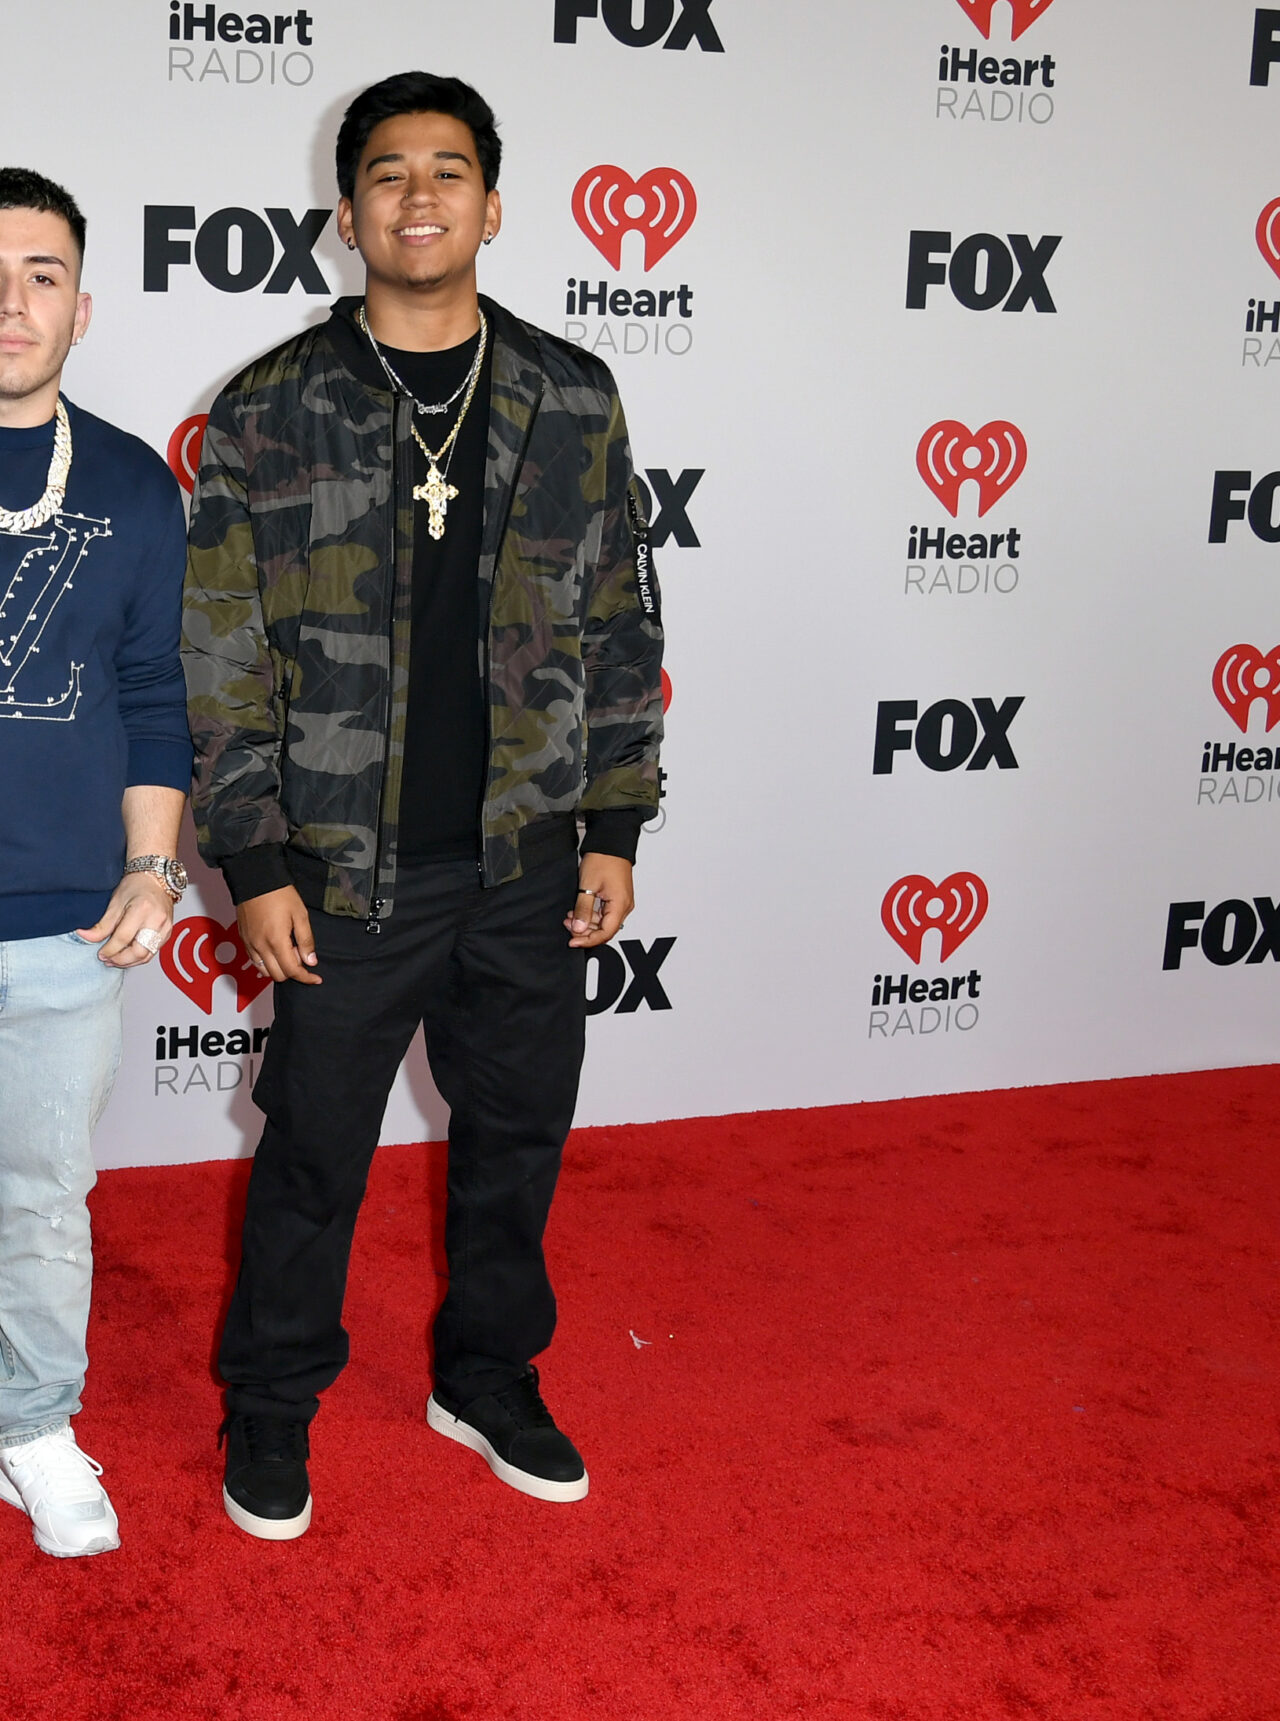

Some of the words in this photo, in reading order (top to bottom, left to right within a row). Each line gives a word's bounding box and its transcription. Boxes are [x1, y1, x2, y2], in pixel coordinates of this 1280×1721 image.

[169, 0, 313, 46] iHeart
[169, 47, 314, 86] RADIO
[939, 44, 1056, 88] iHeart
[936, 87, 1055, 124] RADIO
[143, 205, 333, 295] FOX
[906, 230, 1063, 313] FOX
[566, 278, 693, 318] iHeart
[565, 321, 693, 355] RADIO
[1208, 470, 1280, 543] FO
[907, 525, 1021, 560] iHeart
[637, 544, 648, 583] CALVIN
[905, 564, 1020, 595] RADIO
[640, 585, 655, 613] KLEIN
[873, 696, 1025, 775] FOX
[1201, 741, 1280, 773] iHea
[1197, 775, 1280, 805] RADI
[1162, 897, 1280, 970] FOX
[585, 936, 677, 1015] OX
[871, 970, 981, 1005] iHeart
[868, 1003, 979, 1039] RADIO
[156, 1025, 270, 1060] iHear
[155, 1059, 254, 1096] RADI
